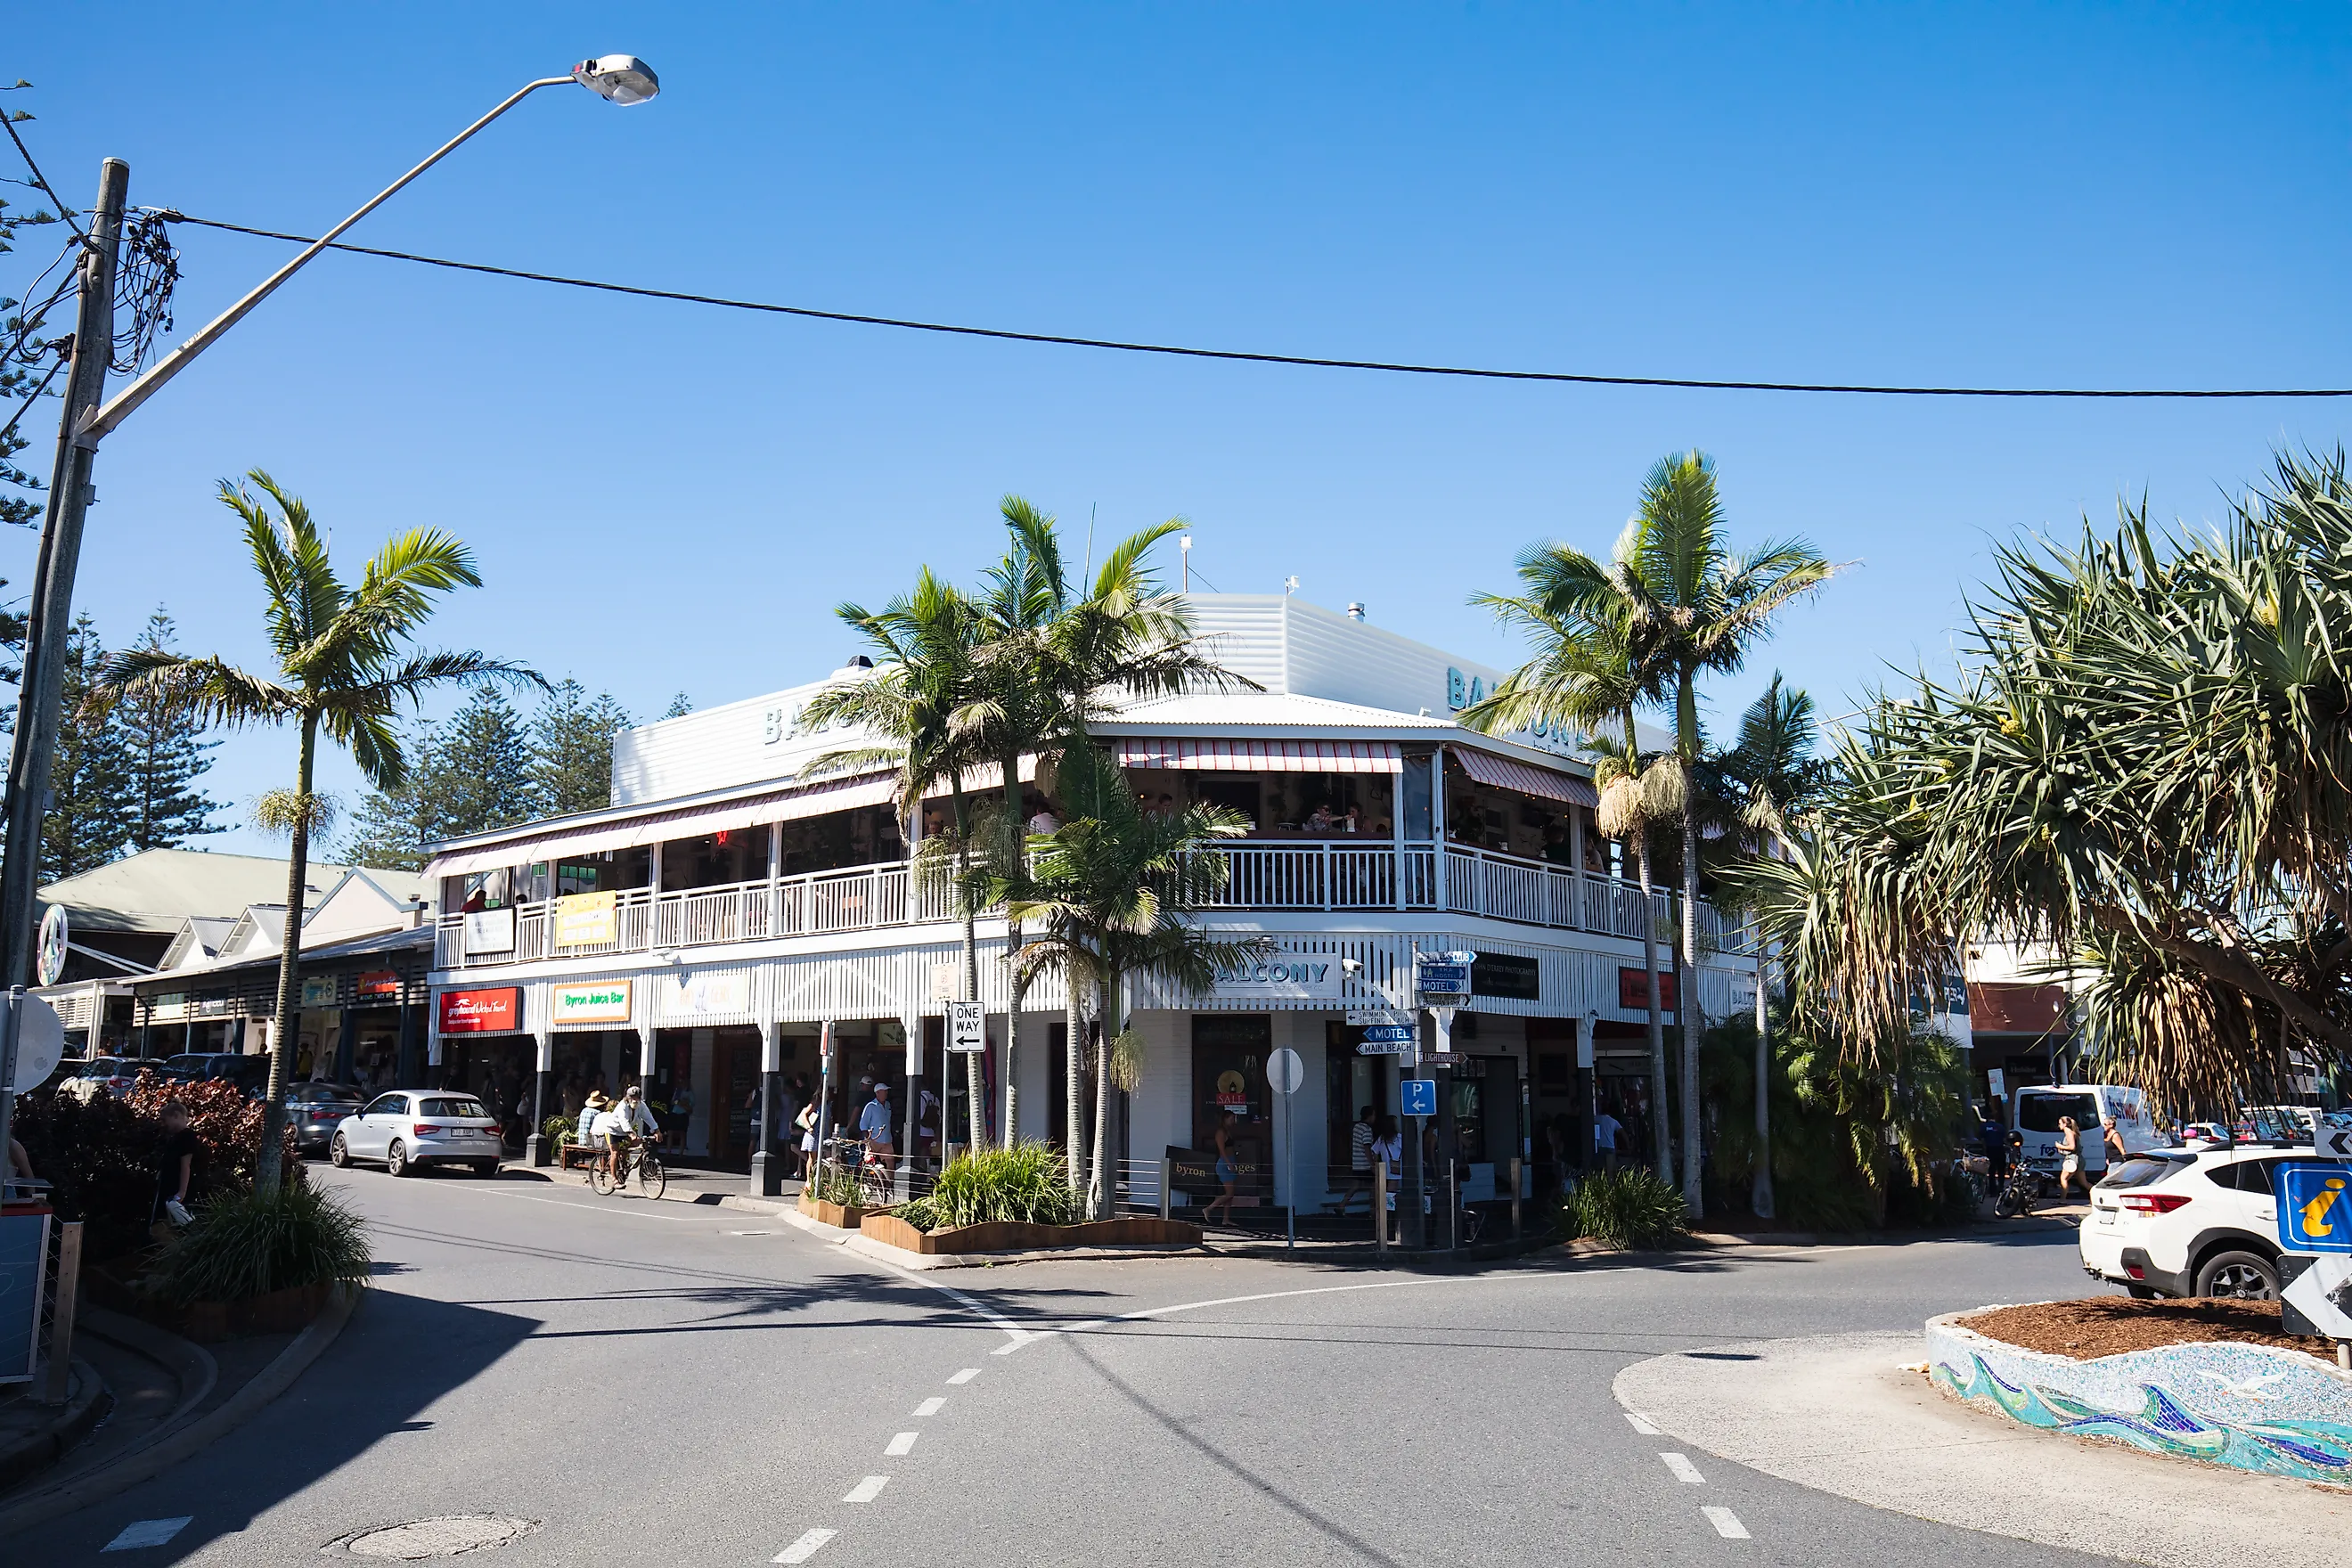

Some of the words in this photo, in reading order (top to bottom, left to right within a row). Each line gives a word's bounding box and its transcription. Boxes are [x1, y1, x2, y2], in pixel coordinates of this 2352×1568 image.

[1452, 951, 1470, 962] CLUB
[1205, 962, 1329, 984] ALCONY
[1423, 982, 1452, 992] MOTEL
[565, 994, 586, 1008] Byron
[589, 992, 608, 1005] Juice
[611, 992, 625, 1003] Bar
[957, 1008, 979, 1018] ONE
[956, 1021, 980, 1032] WAY
[1376, 1028, 1410, 1040] MOTEL
[1365, 1044, 1384, 1053] MAIN
[1386, 1042, 1411, 1052] BEACH
[1425, 1053, 1459, 1063] LIGHTHOUSE
[1413, 1083, 1423, 1097] P
[1219, 1094, 1244, 1103] SALE
[1176, 1163, 1206, 1177] byron
